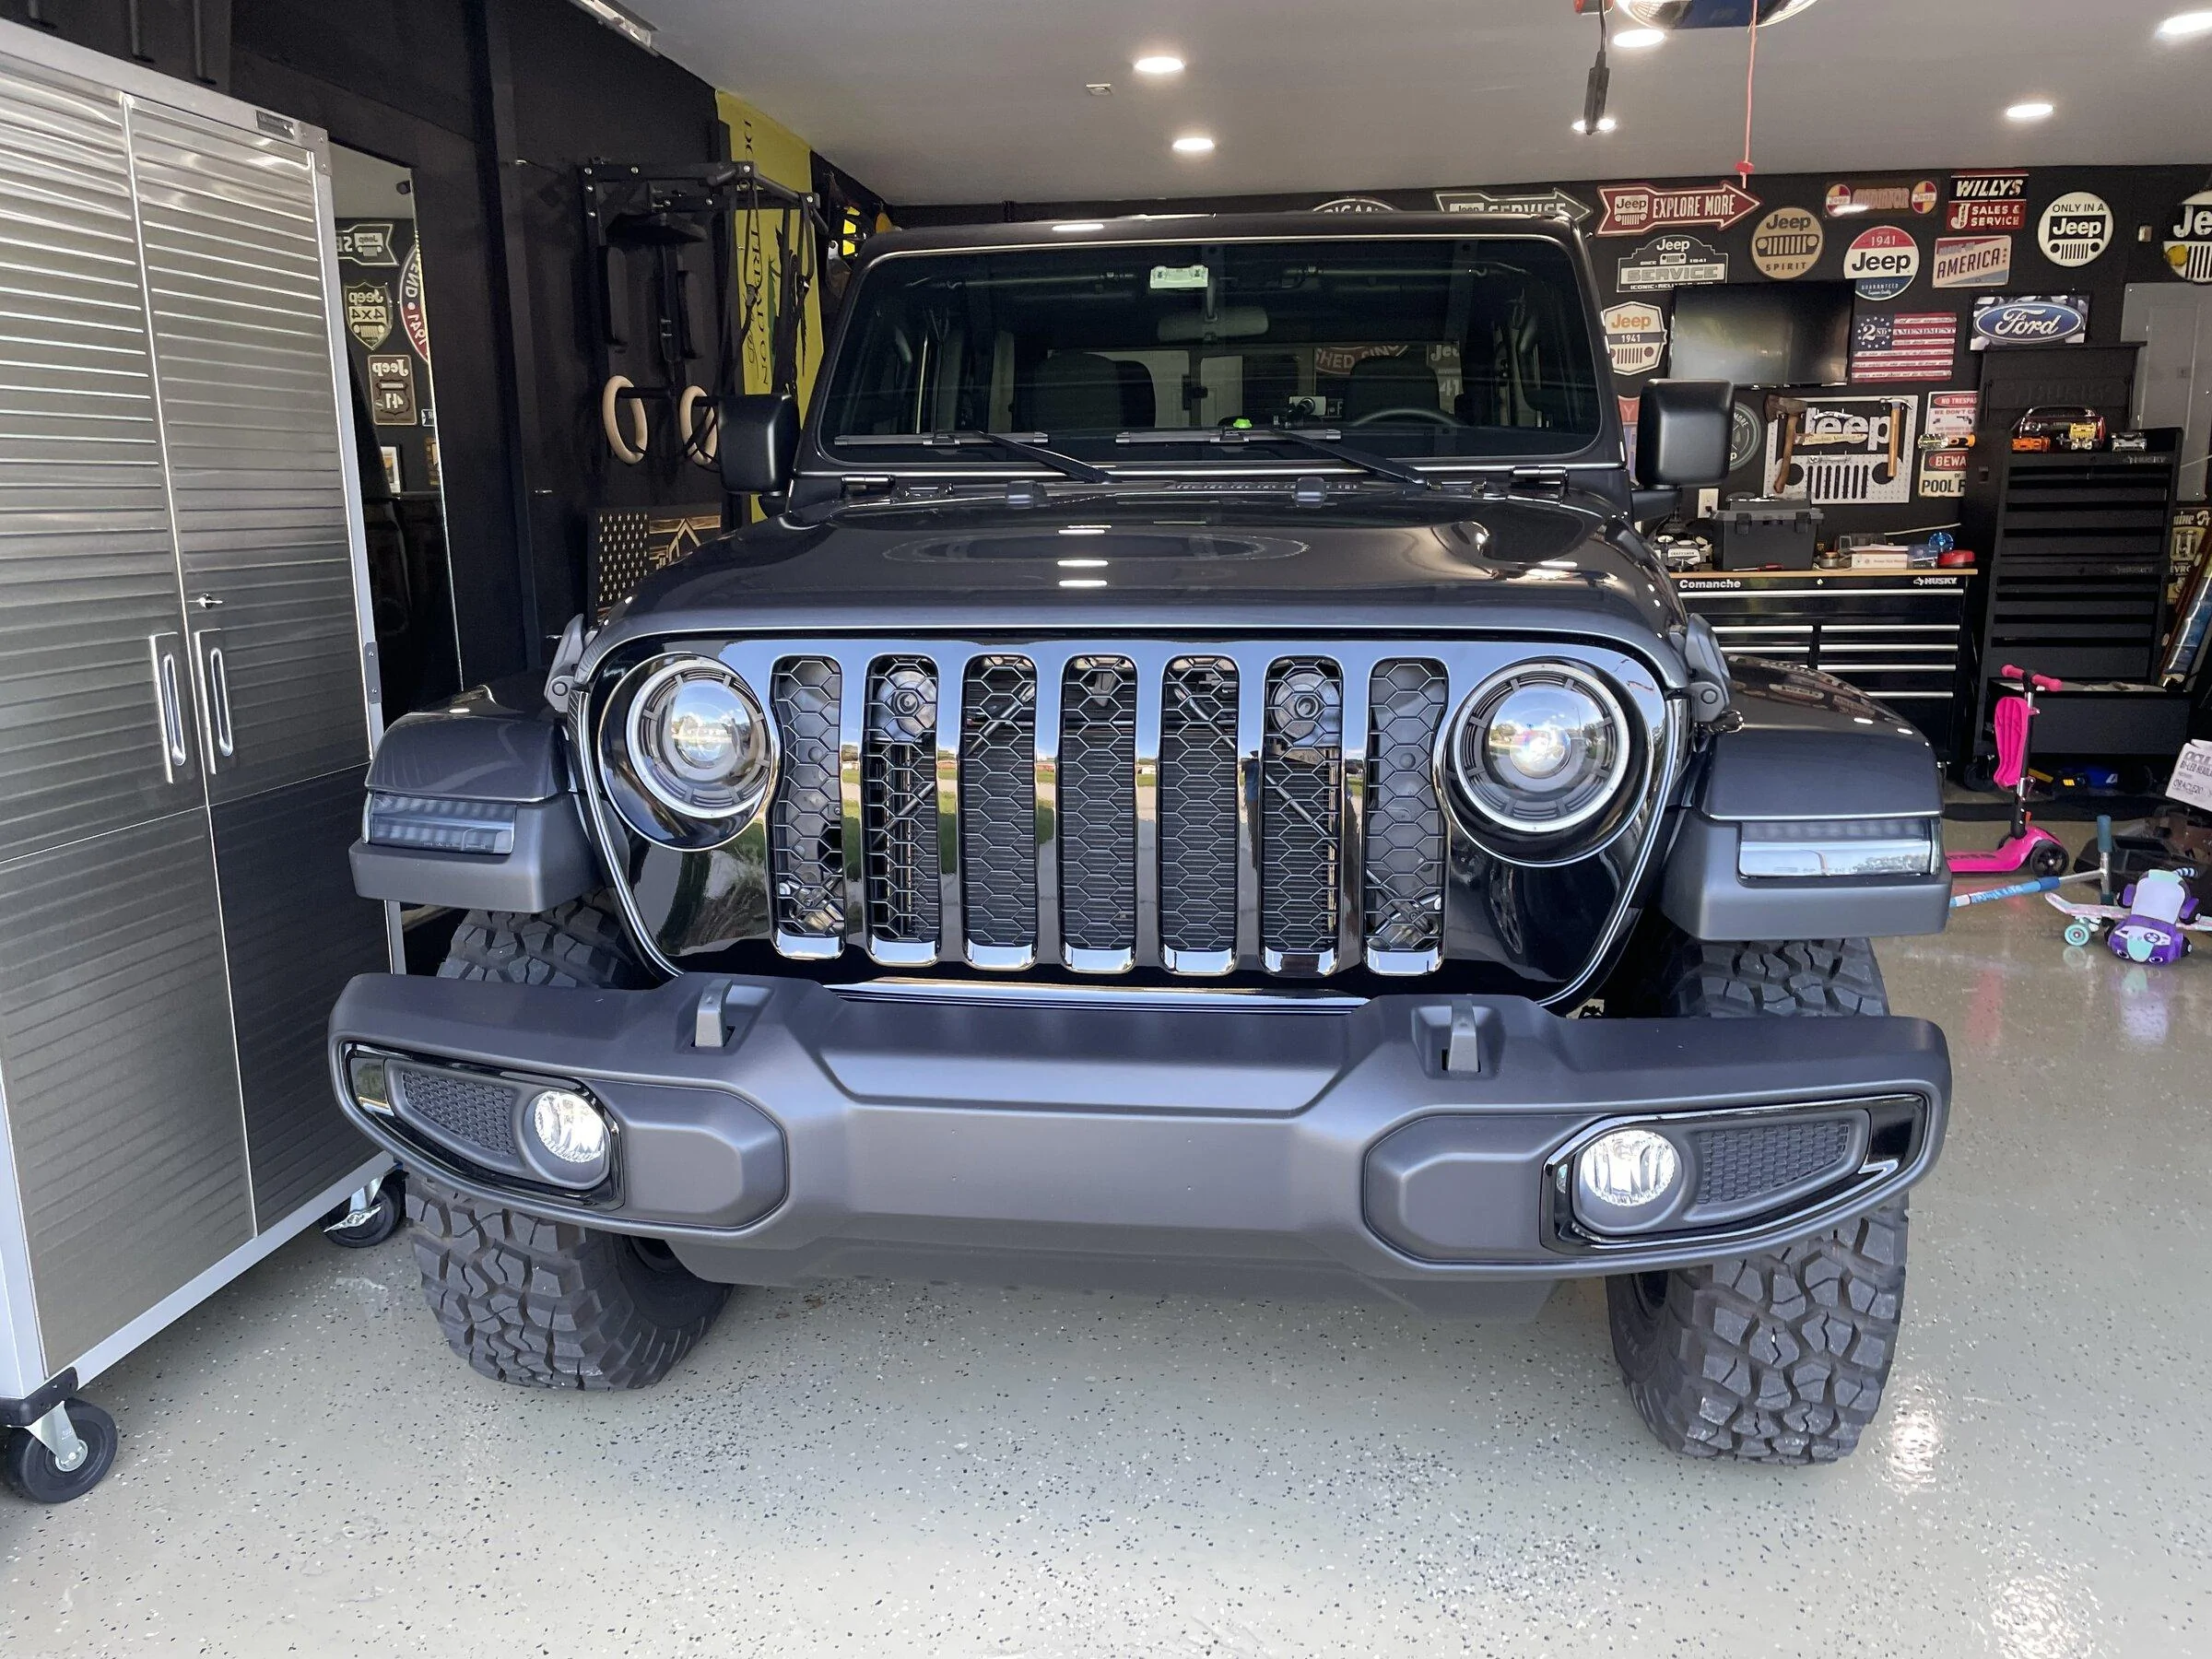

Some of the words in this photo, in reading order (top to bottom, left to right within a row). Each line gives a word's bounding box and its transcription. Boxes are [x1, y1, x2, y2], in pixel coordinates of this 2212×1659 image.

[1616, 197, 1647, 210] Jeep
[1653, 195, 1700, 218] EXPLORE
[1704, 194, 1735, 217] MORE
[2052, 204, 2081, 213] ONLY
[2083, 203, 2095, 212] IN
[2097, 203, 2105, 211] A
[1971, 206, 2009, 216] SALES
[1766, 214, 1811, 231] Jeep
[1971, 216, 2020, 227] SERVICE
[2052, 218, 2102, 238] Jeep
[1656, 238, 1690, 253] Jeep
[1871, 235, 1896, 246] 1941
[1765, 261, 1807, 272] SPIRIT
[1852, 252, 1911, 274] Jeep
[1936, 248, 1999, 279] AMERICA
[1627, 265, 1718, 282] SERVICE
[1611, 313, 1652, 331] Jeep
[1994, 308, 2062, 335] Ford
[1621, 334, 1641, 343] 1941
[1935, 455, 1967, 467] BEWA
[1921, 479, 1954, 493] POOL
[1679, 579, 1741, 589] Comanche
[1924, 577, 1958, 585] HUSKY
